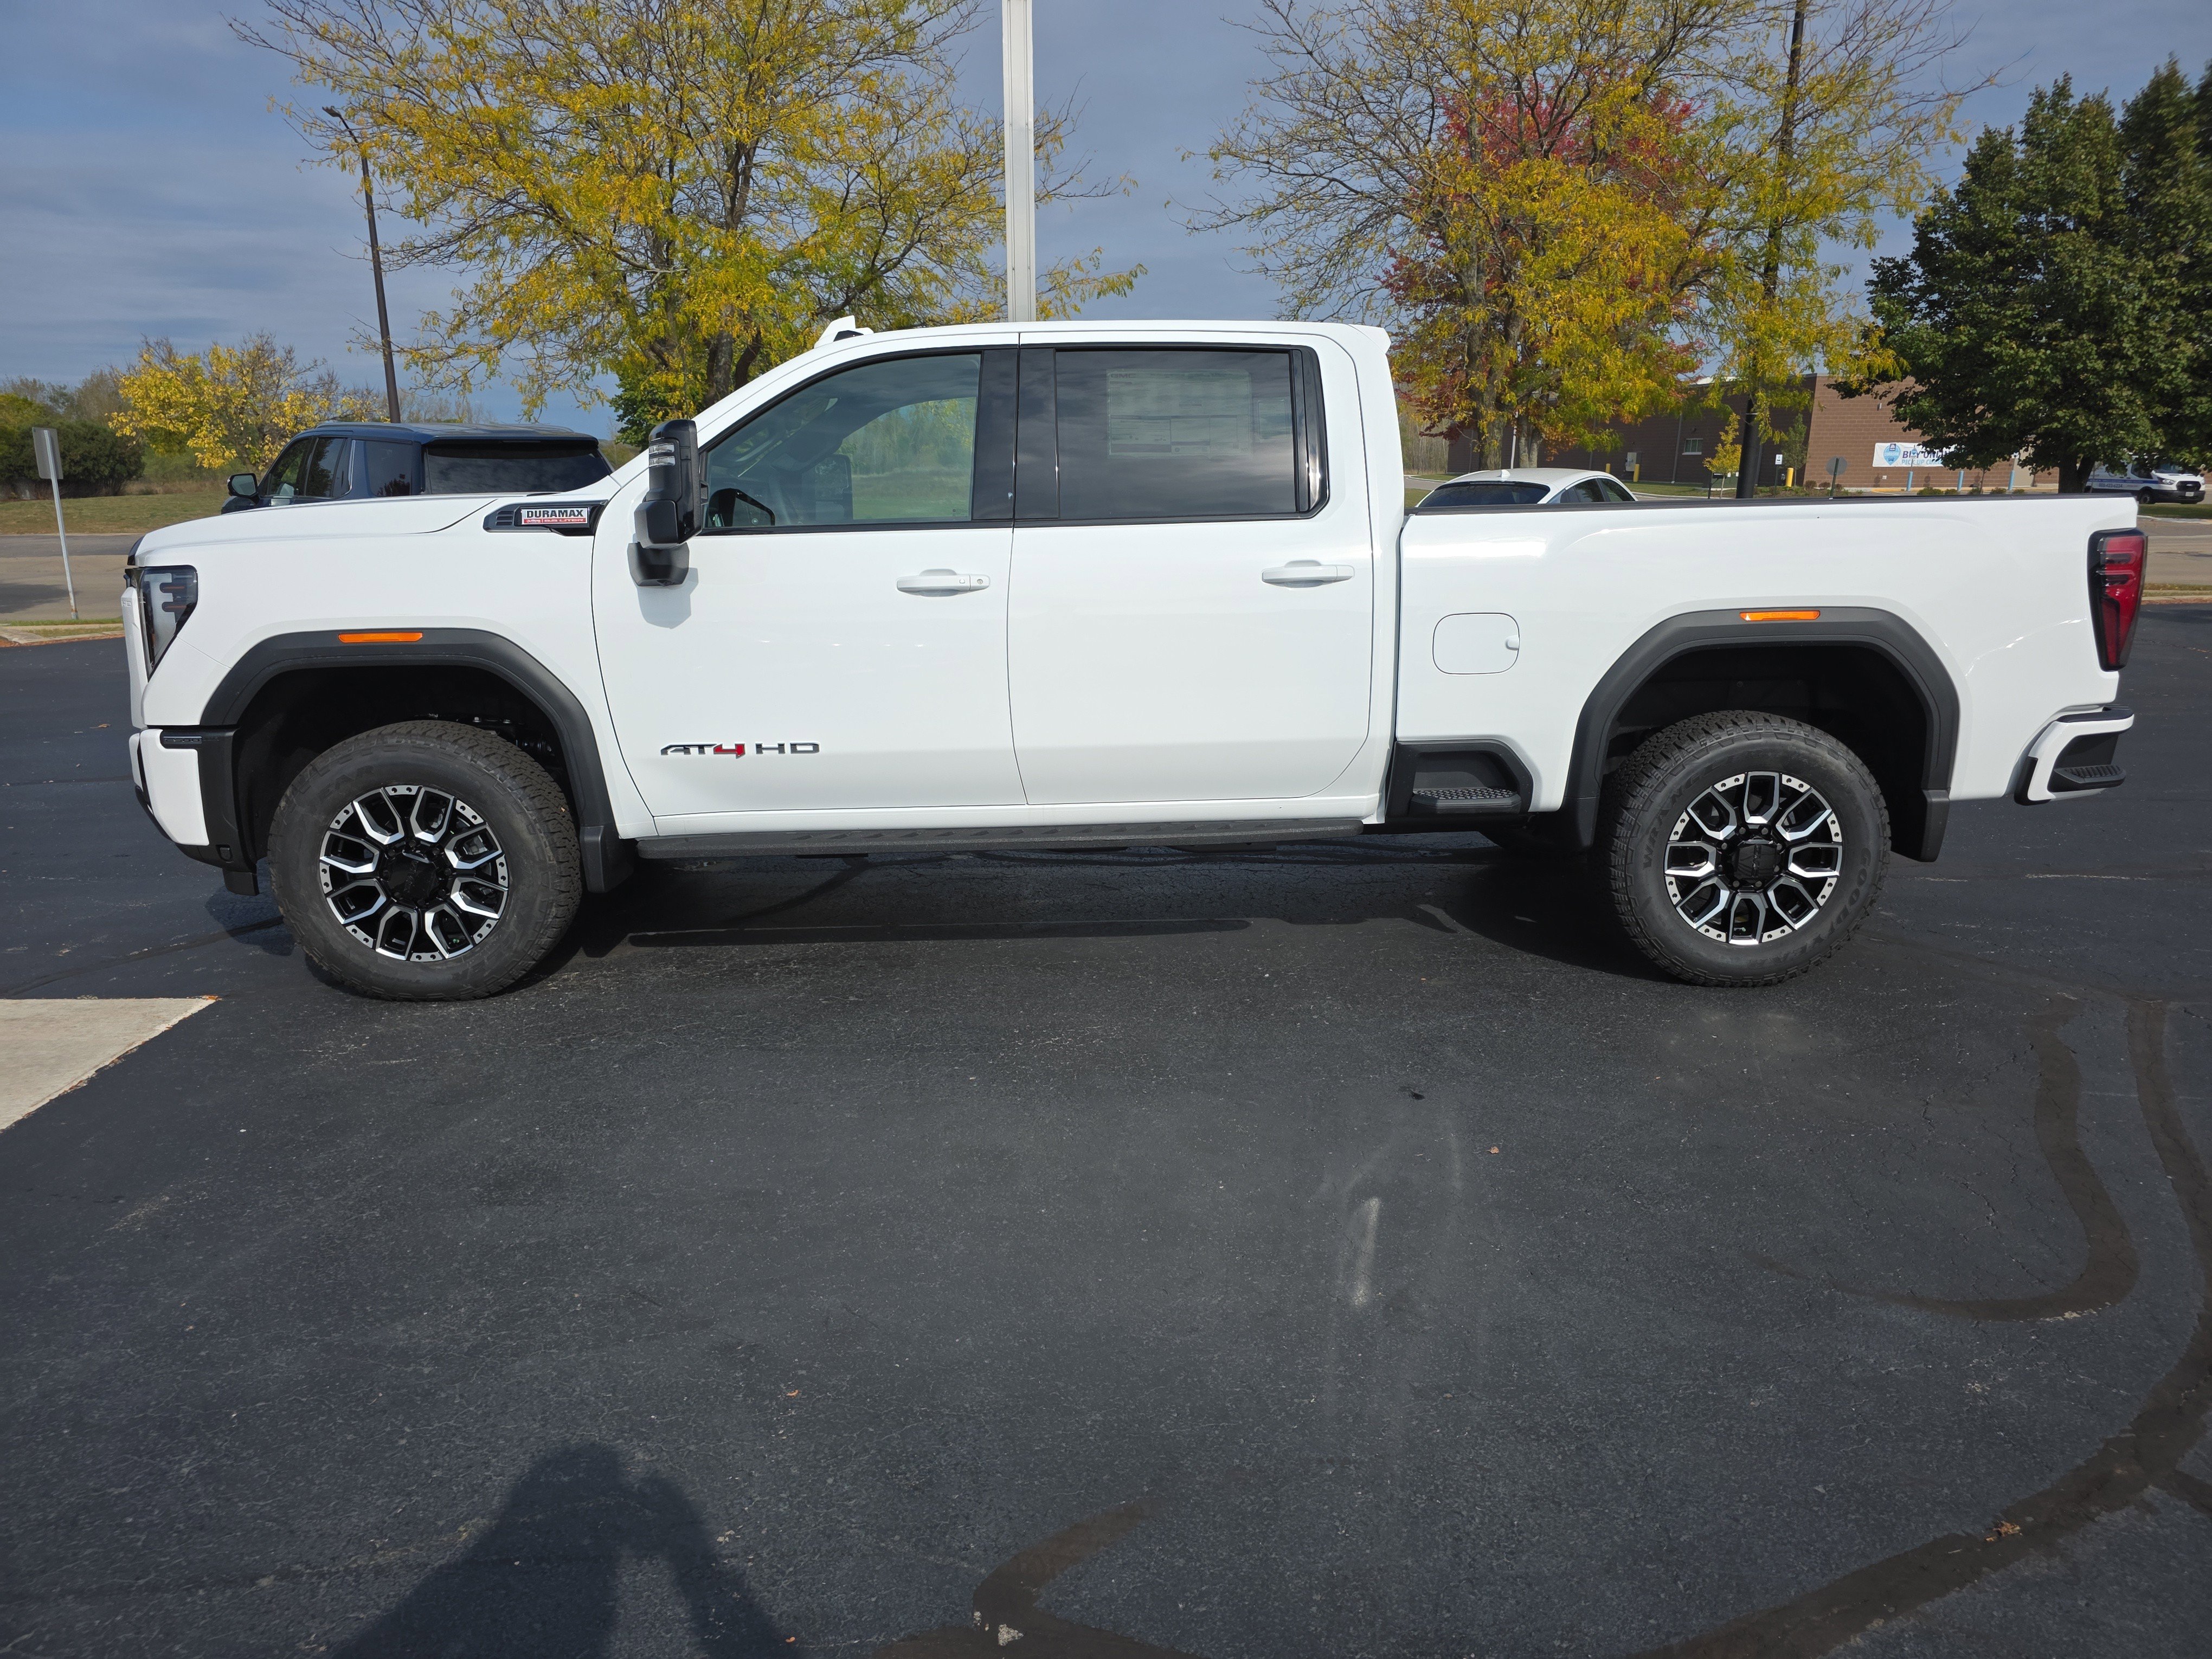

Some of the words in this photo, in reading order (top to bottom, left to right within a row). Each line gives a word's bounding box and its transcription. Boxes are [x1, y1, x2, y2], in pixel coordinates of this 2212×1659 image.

[526, 510, 583, 518] DURAMAX
[660, 743, 745, 759] AT4
[755, 743, 820, 755] HD
